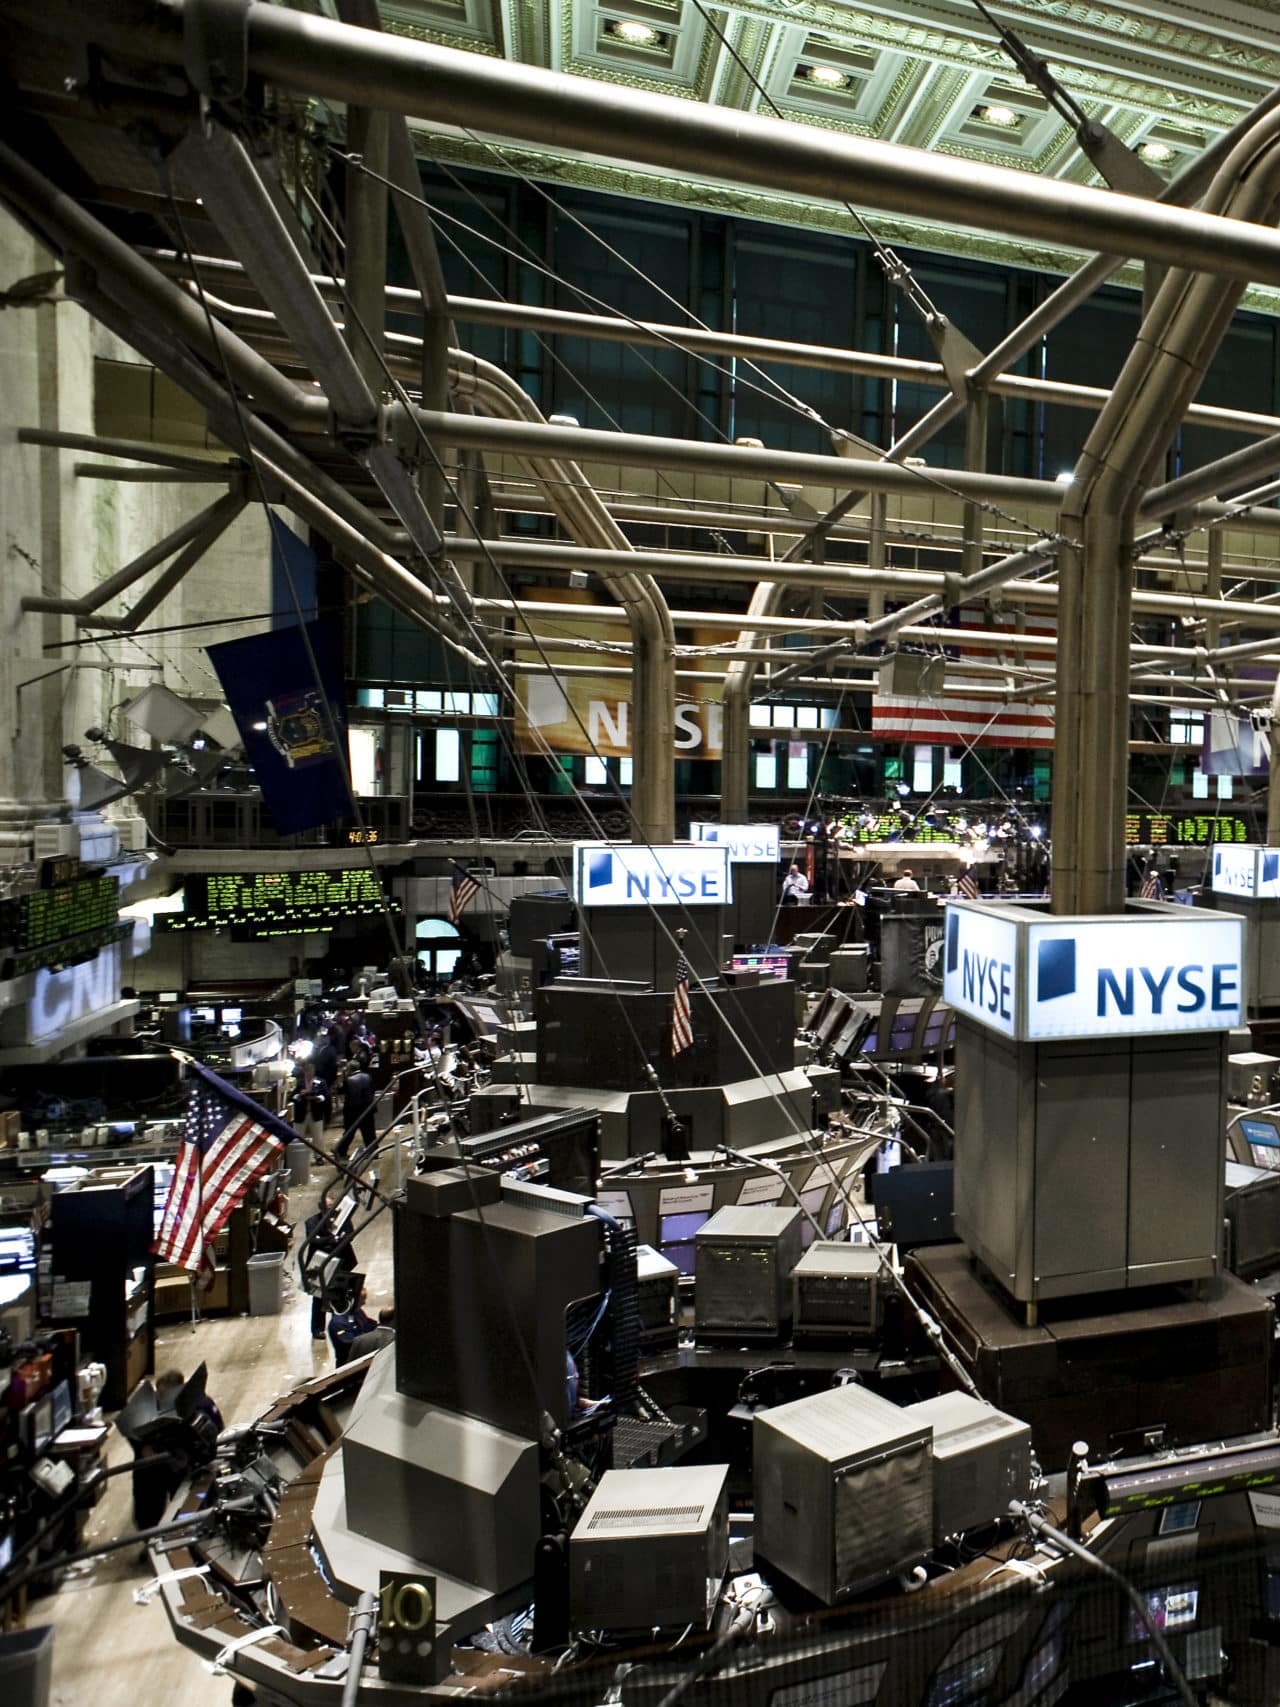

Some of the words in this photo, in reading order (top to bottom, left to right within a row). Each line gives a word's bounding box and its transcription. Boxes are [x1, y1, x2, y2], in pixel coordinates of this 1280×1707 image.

[588, 700, 724, 750] NSE
[727, 842, 776, 857] NYSE
[626, 870, 719, 898] NYSE
[1224, 866, 1254, 889] NYSE
[963, 948, 1011, 1021] NYSE
[1097, 964, 1238, 1017] NYSE
[1252, 1075, 1261, 1092] 8
[380, 1580, 432, 1630] 10
